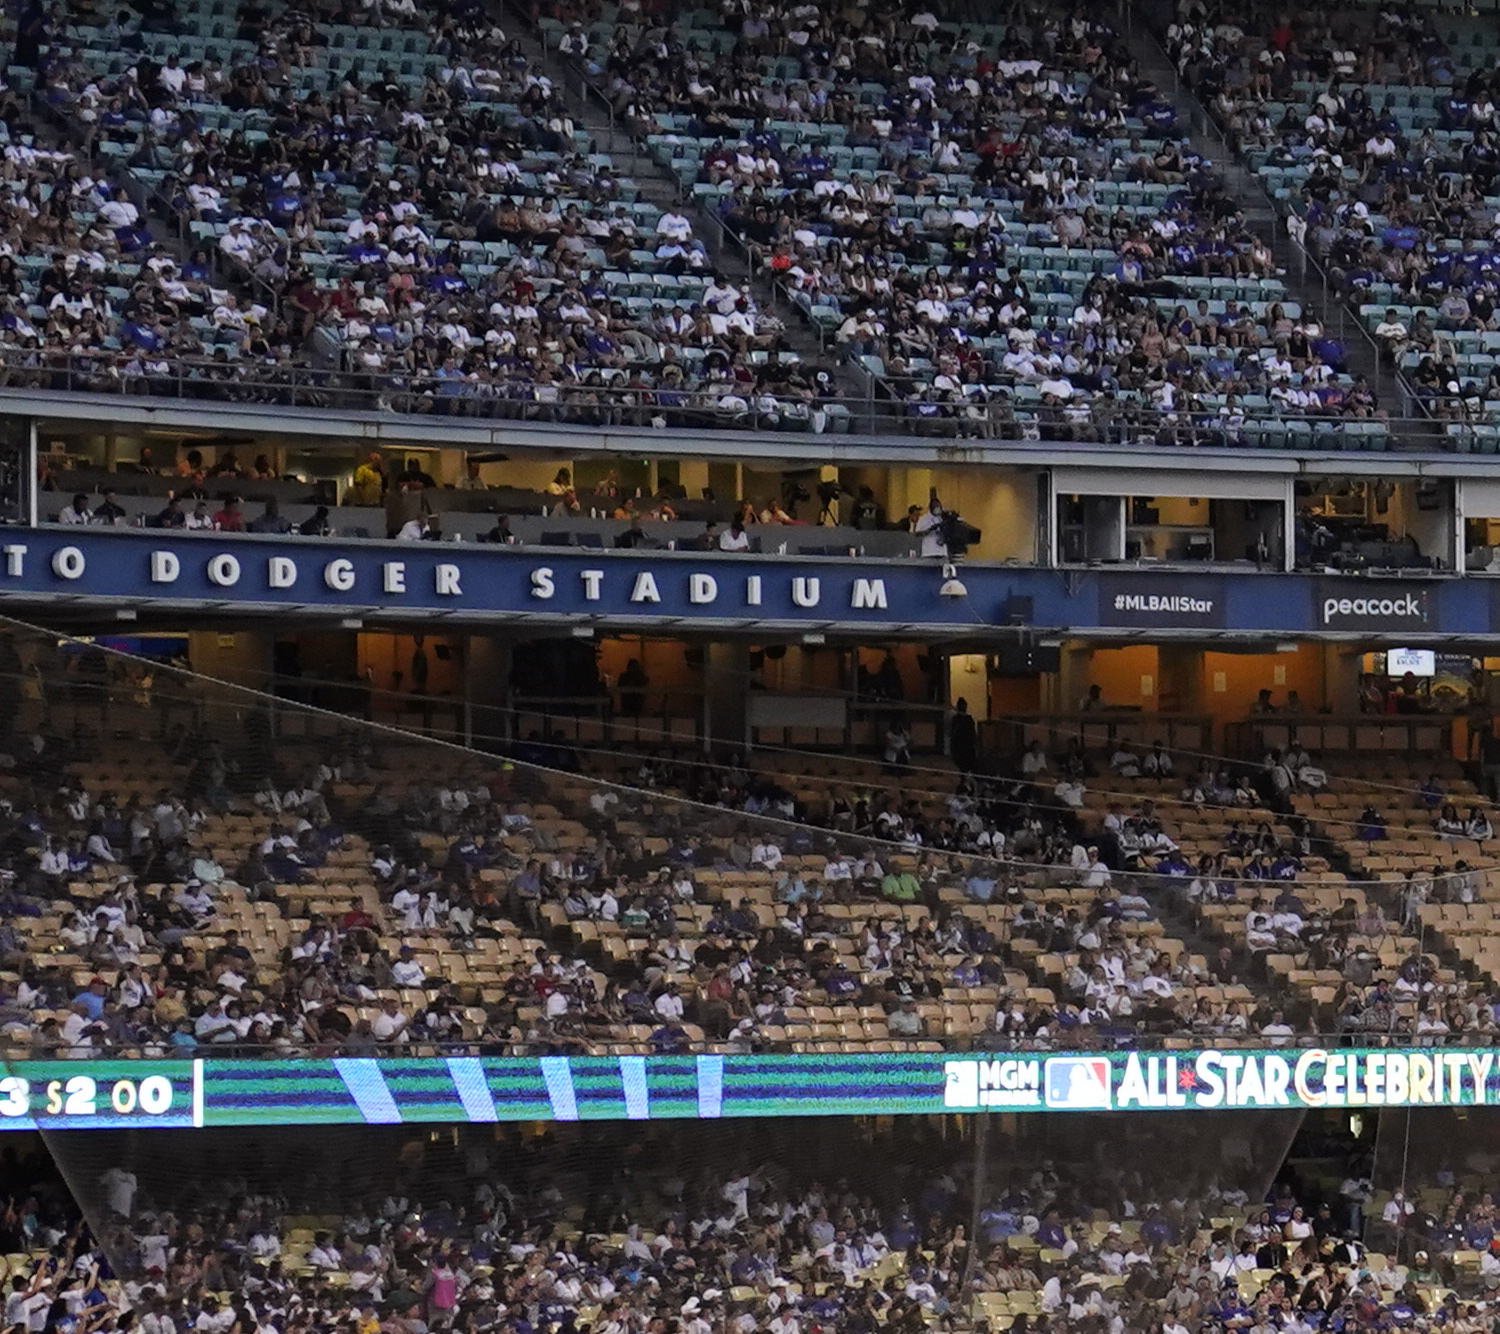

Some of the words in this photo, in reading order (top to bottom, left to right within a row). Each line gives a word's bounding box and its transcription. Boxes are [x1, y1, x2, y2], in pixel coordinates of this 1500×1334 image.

[3, 544, 86, 579] TO
[151, 550, 463, 595] DODGER
[531, 567, 888, 609] STADIUM
[1114, 593, 1213, 613] #MLBAllStar
[1323, 596, 1420, 624] peacock
[979, 1060, 1039, 1090] MGM
[1118, 1051, 1187, 1107] ALL
[1195, 1050, 1290, 1107] STAR
[1294, 1048, 1495, 1107] CELEBRITY
